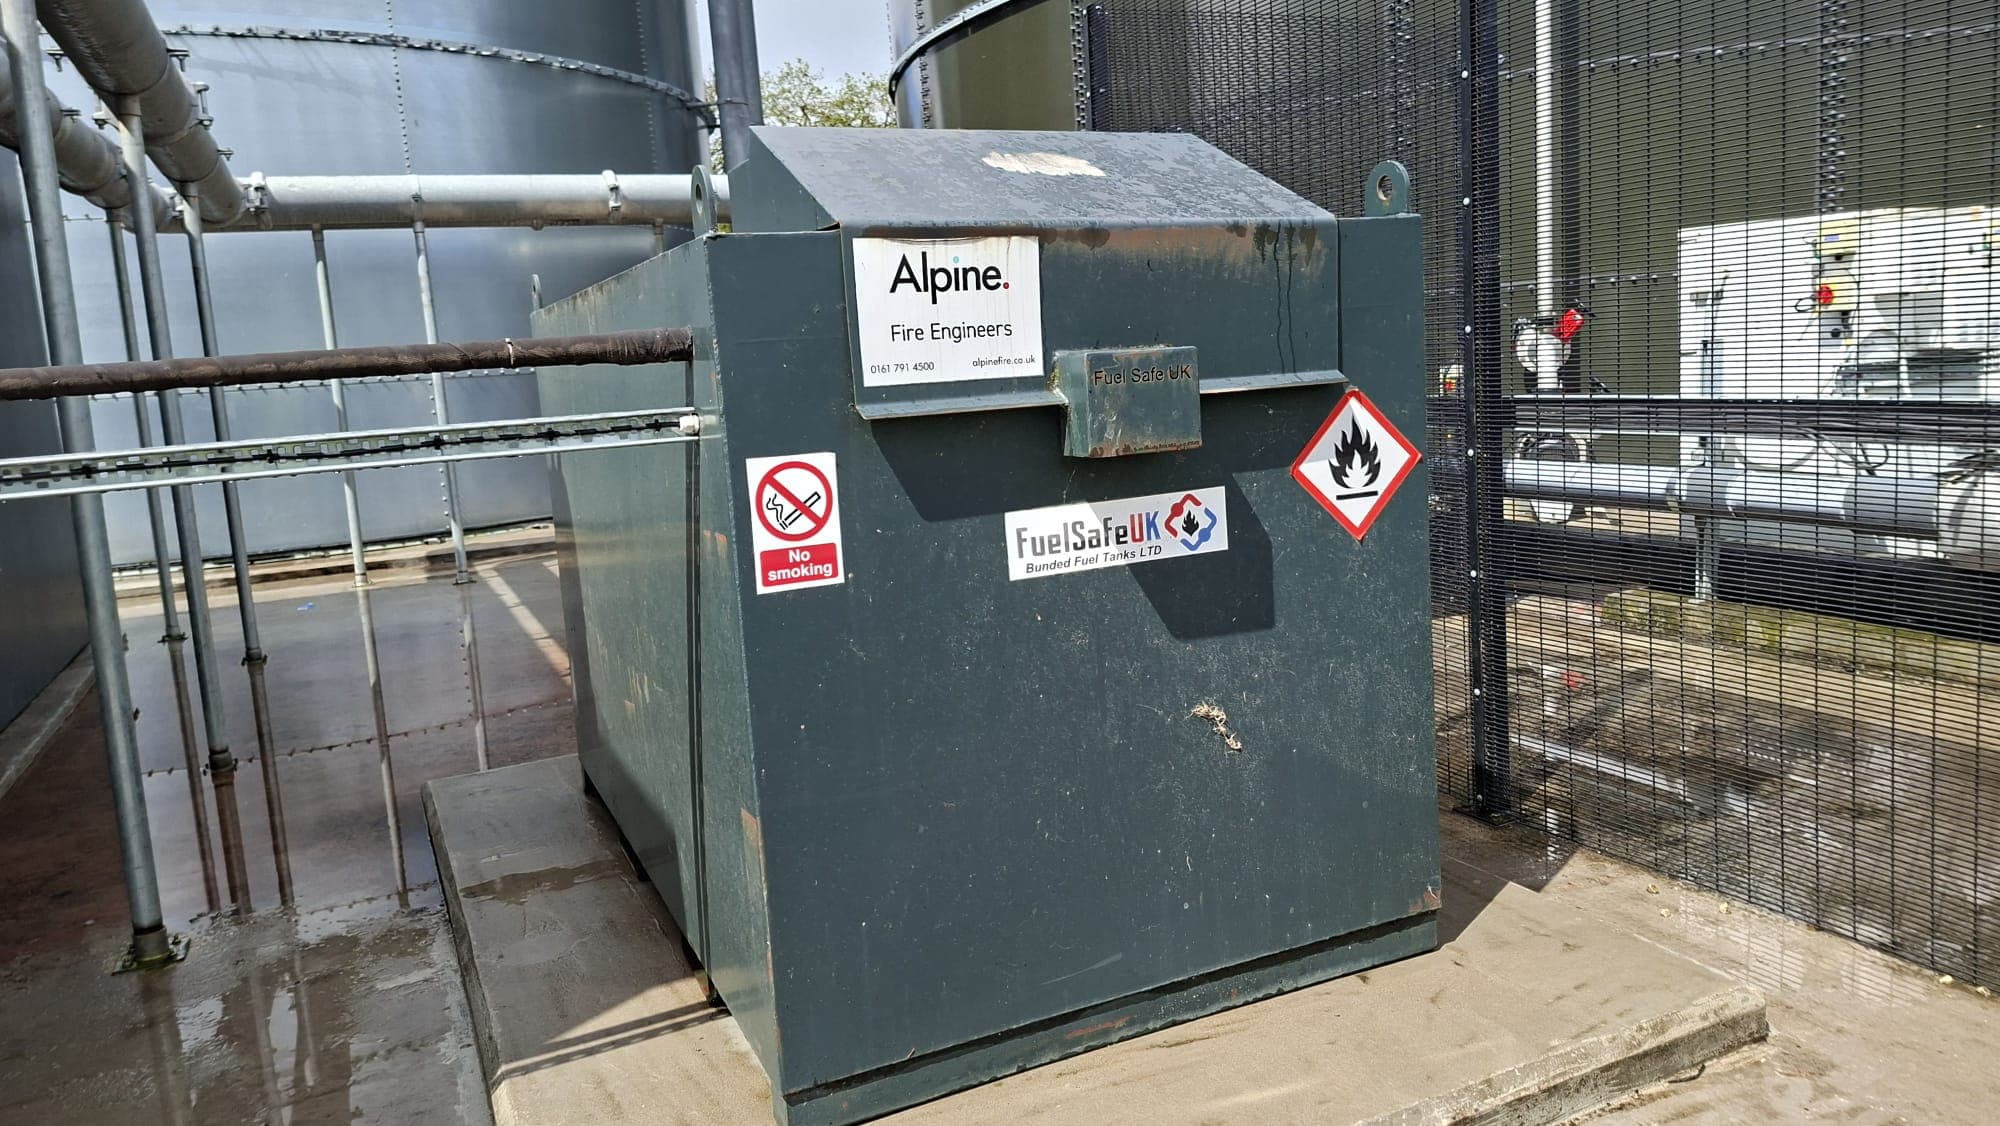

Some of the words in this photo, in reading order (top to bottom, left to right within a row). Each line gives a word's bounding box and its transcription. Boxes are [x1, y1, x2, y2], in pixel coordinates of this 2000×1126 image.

[889, 251, 1010, 305] Alpine.
[891, 324, 924, 342] Fire
[930, 321, 1013, 343] Engineers
[870, 364, 890, 374] 0161
[894, 363, 909, 373] 791
[912, 361, 935, 372] 4500
[972, 354, 1036, 368] alpinefire.co.uk
[1094, 369, 1127, 386] Fuel
[1131, 366, 1164, 383] Safe
[1168, 364, 1191, 380] UK
[788, 548, 811, 563] No
[1026, 557, 1071, 574] Bunded
[1074, 554, 1099, 568] Fuel
[1103, 550, 1136, 563] Tanks
[1139, 545, 1162, 558] LTD
[767, 563, 833, 581] smoking
